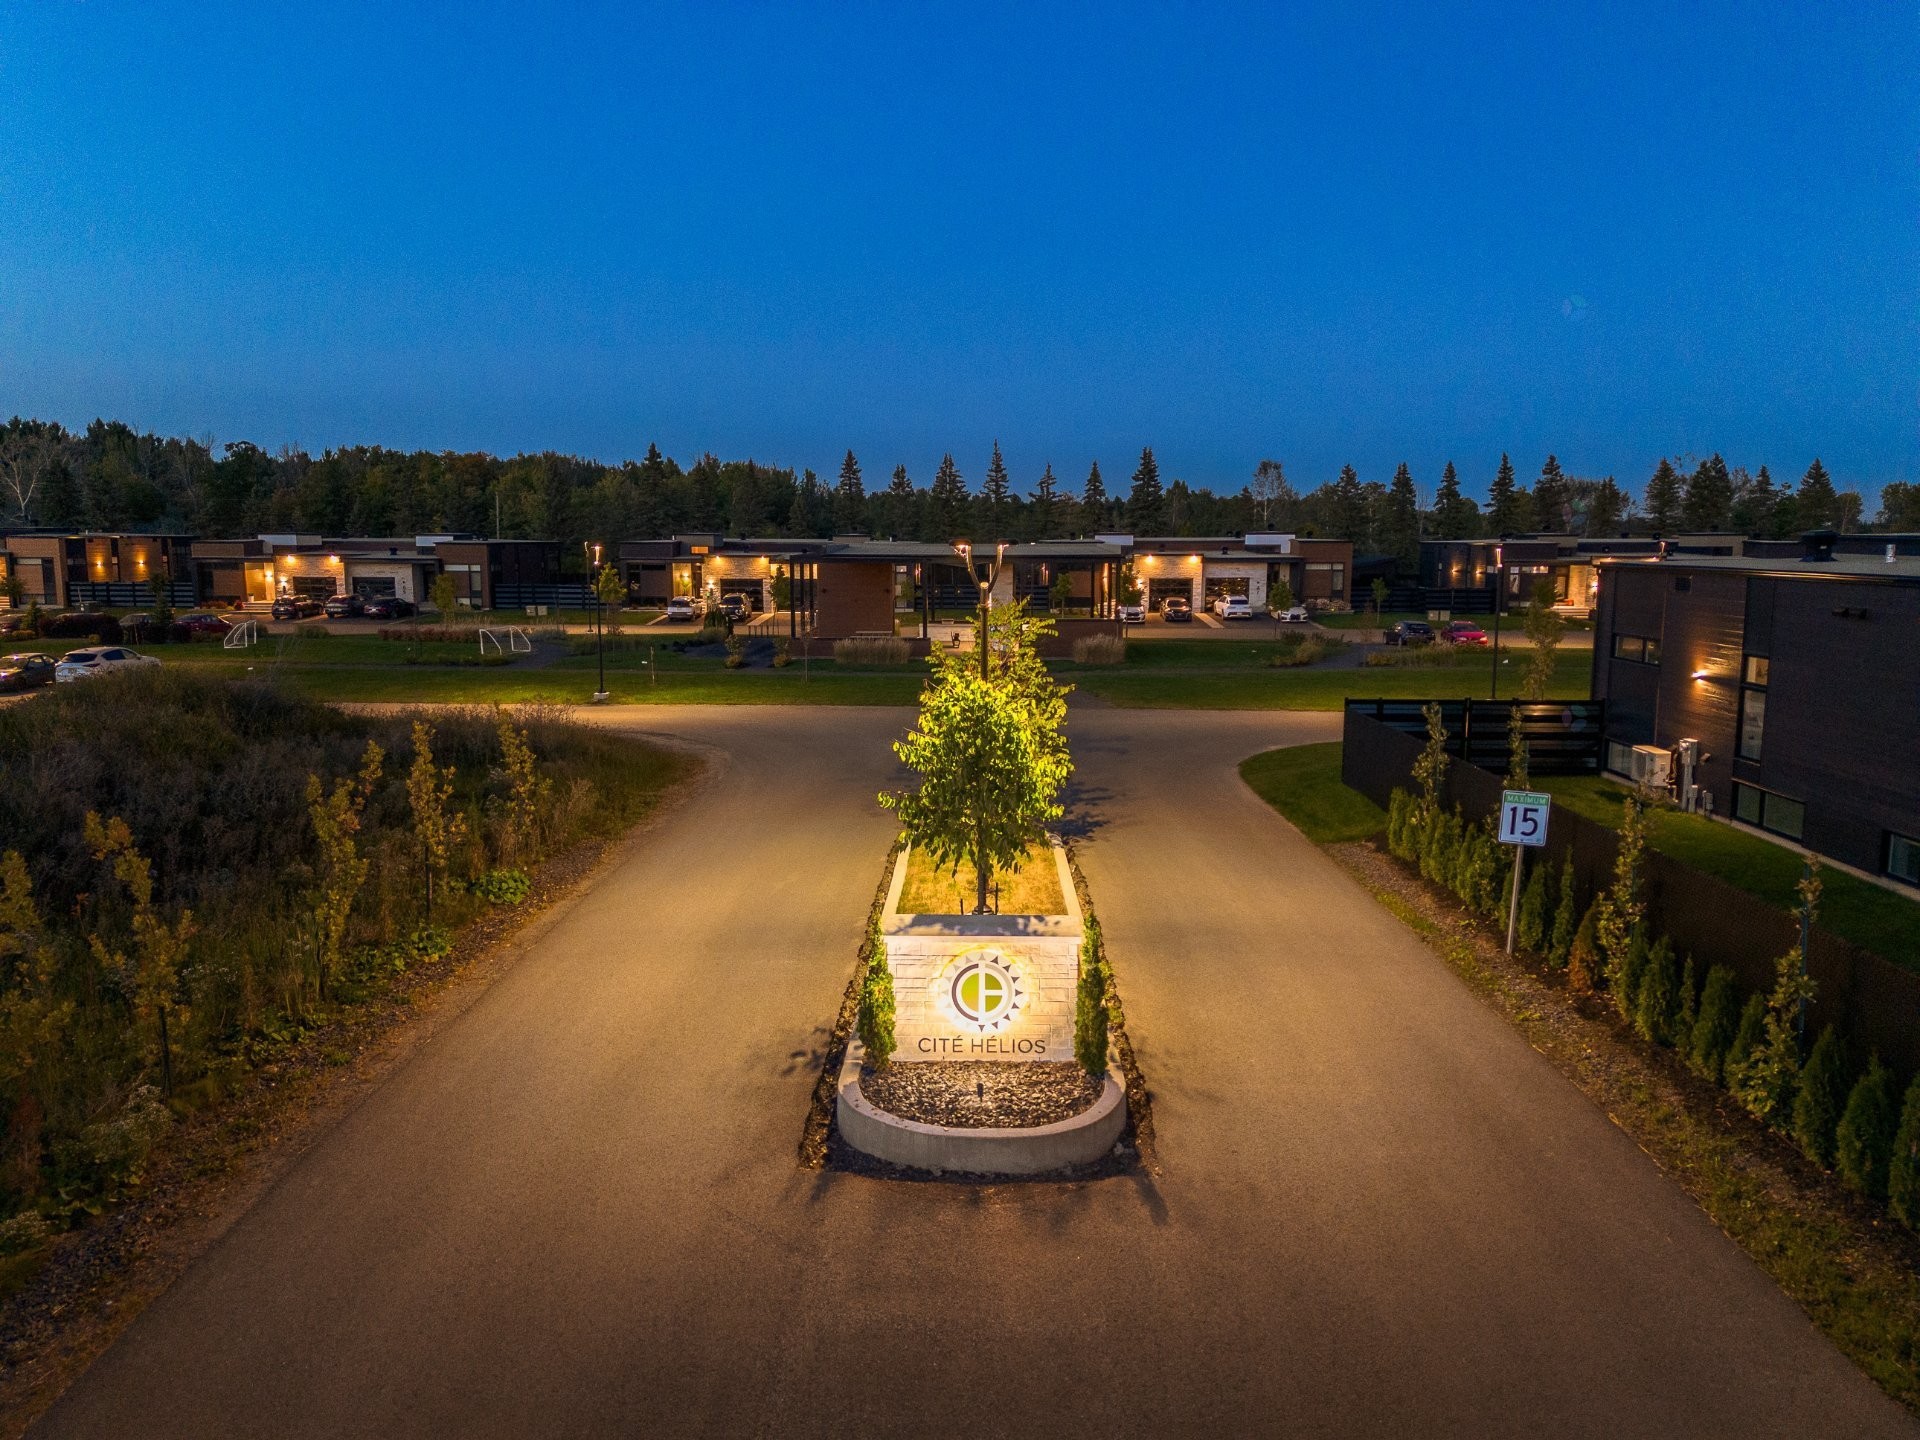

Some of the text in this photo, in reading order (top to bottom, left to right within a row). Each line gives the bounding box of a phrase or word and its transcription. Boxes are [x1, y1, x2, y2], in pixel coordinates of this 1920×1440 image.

[1507, 795, 1547, 804] MAXIMUM
[1509, 806, 1539, 836] 15
[918, 1035, 1046, 1054] CITÉ HÉLIOS
